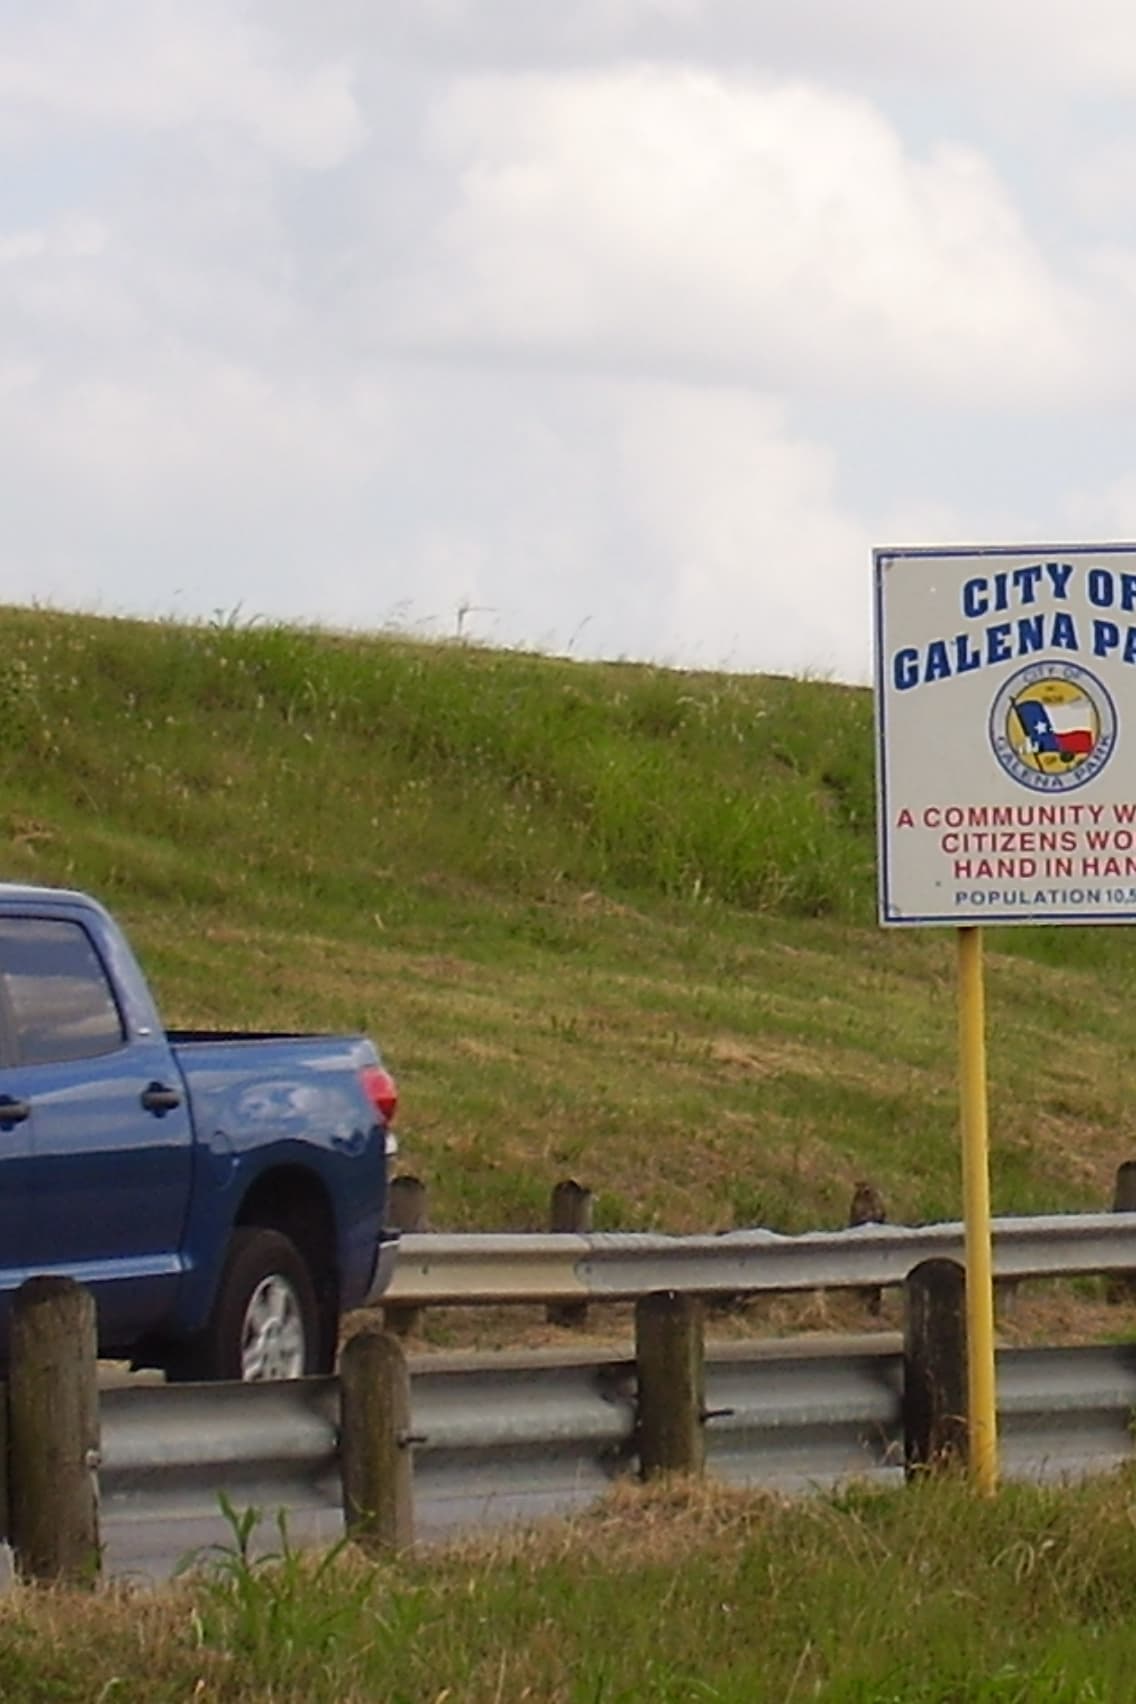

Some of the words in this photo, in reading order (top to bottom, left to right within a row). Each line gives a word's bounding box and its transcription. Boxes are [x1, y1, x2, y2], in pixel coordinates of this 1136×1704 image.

[962, 562, 1074, 618] CITY
[893, 612, 1078, 692] GALENA
[896, 809, 914, 828] A
[923, 804, 1105, 828] COMMUNITY
[941, 831, 1077, 854] CITIZENS
[954, 858, 1037, 880] HAND
[1046, 857, 1073, 878] IN
[955, 889, 1102, 906] POPULATION
